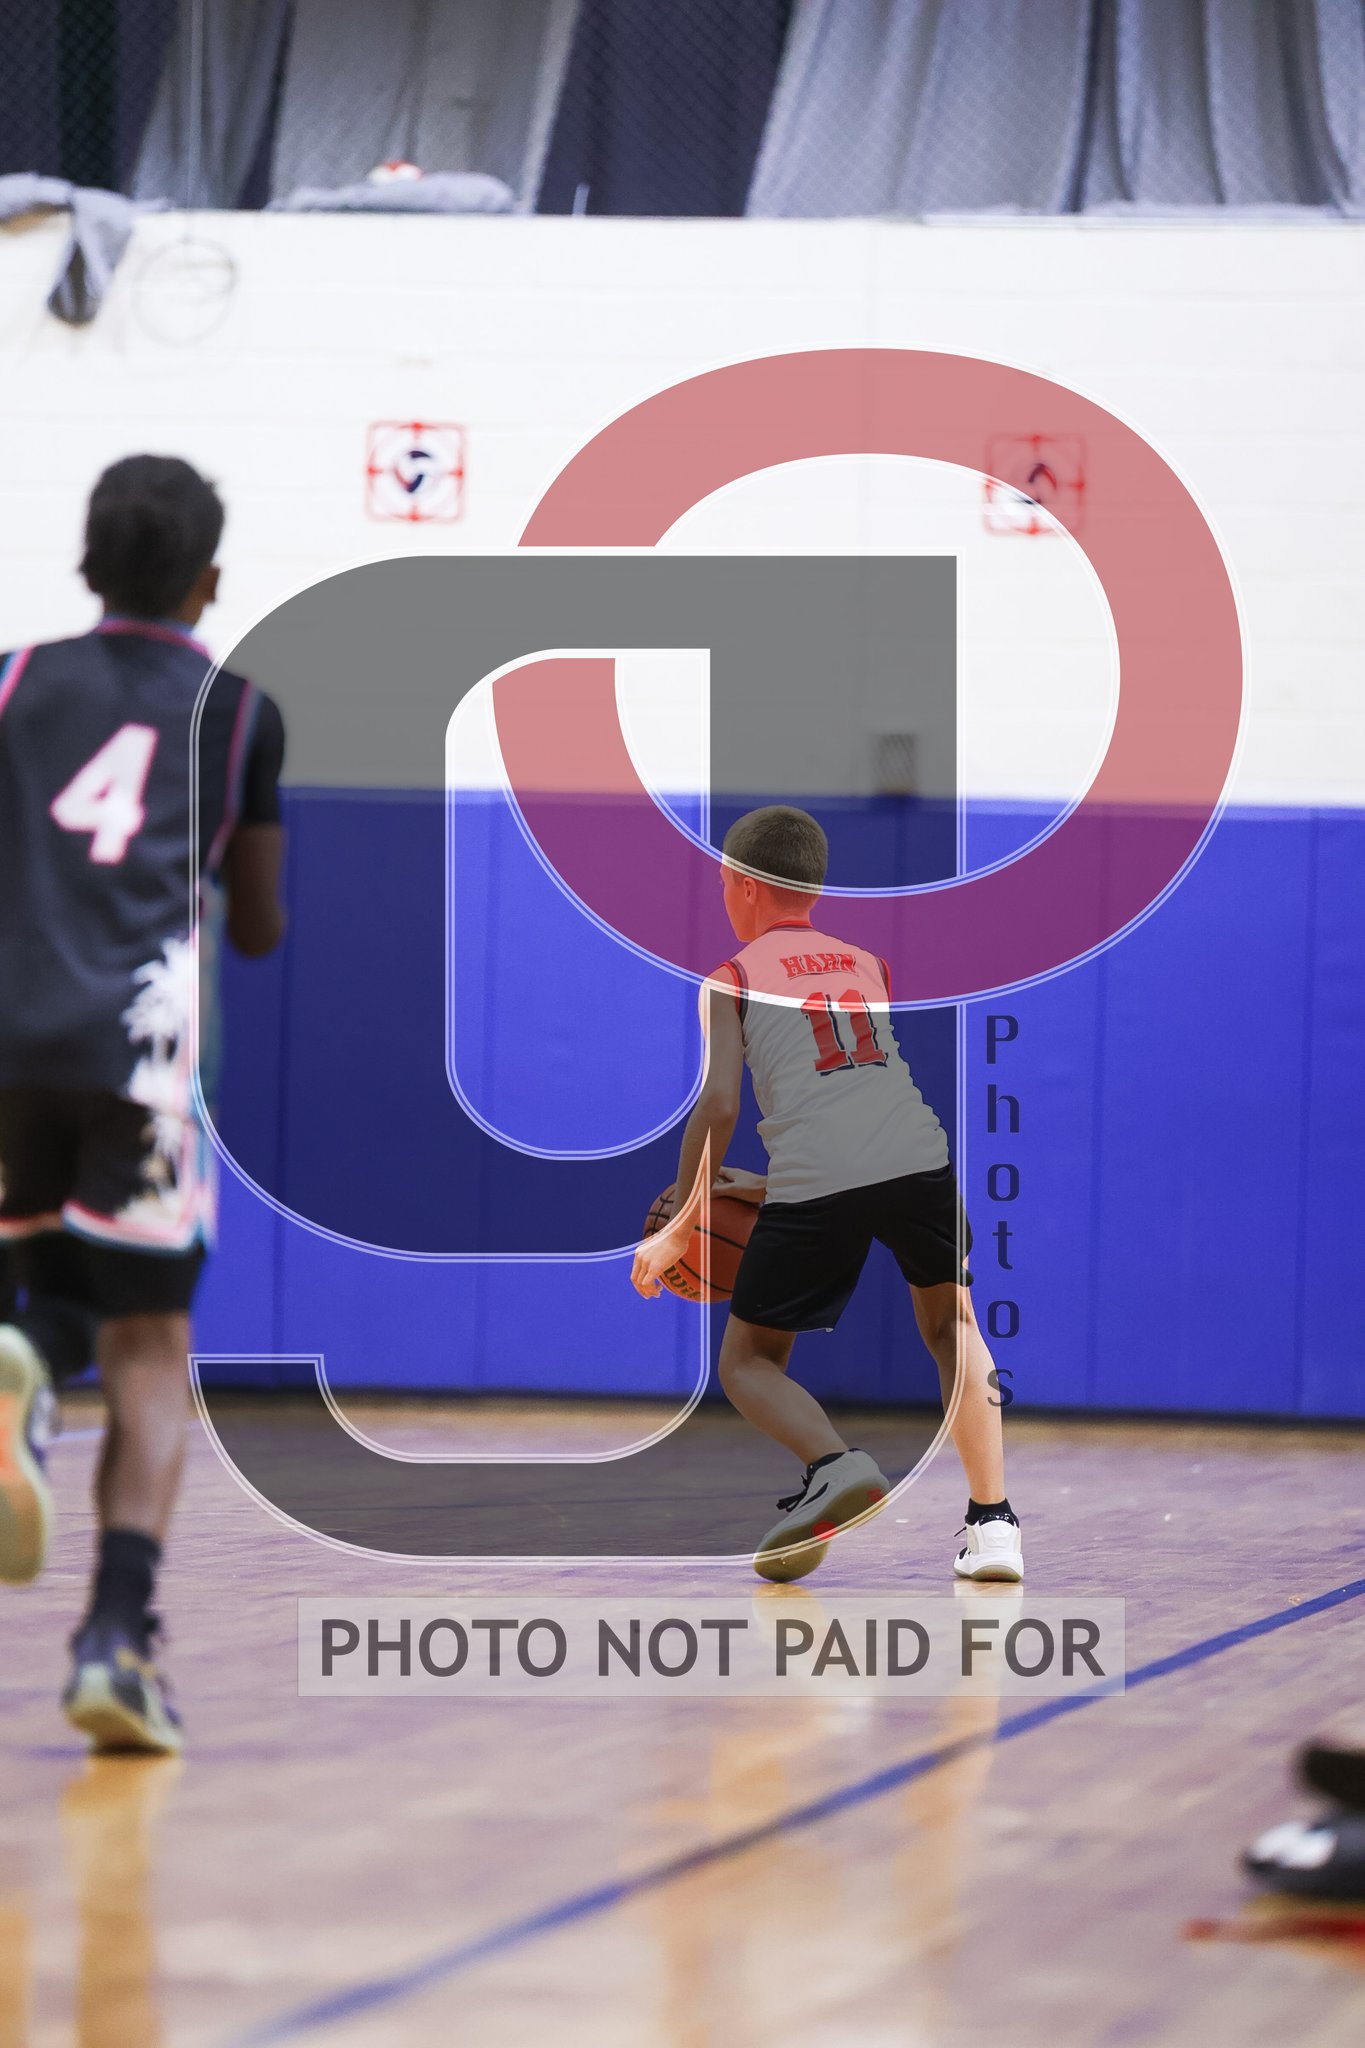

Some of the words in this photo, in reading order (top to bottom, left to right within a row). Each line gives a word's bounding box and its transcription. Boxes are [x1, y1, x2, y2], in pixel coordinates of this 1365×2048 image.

[50, 721, 159, 864] 4
[779, 952, 858, 979] HAHN
[800, 988, 888, 1076] 11
